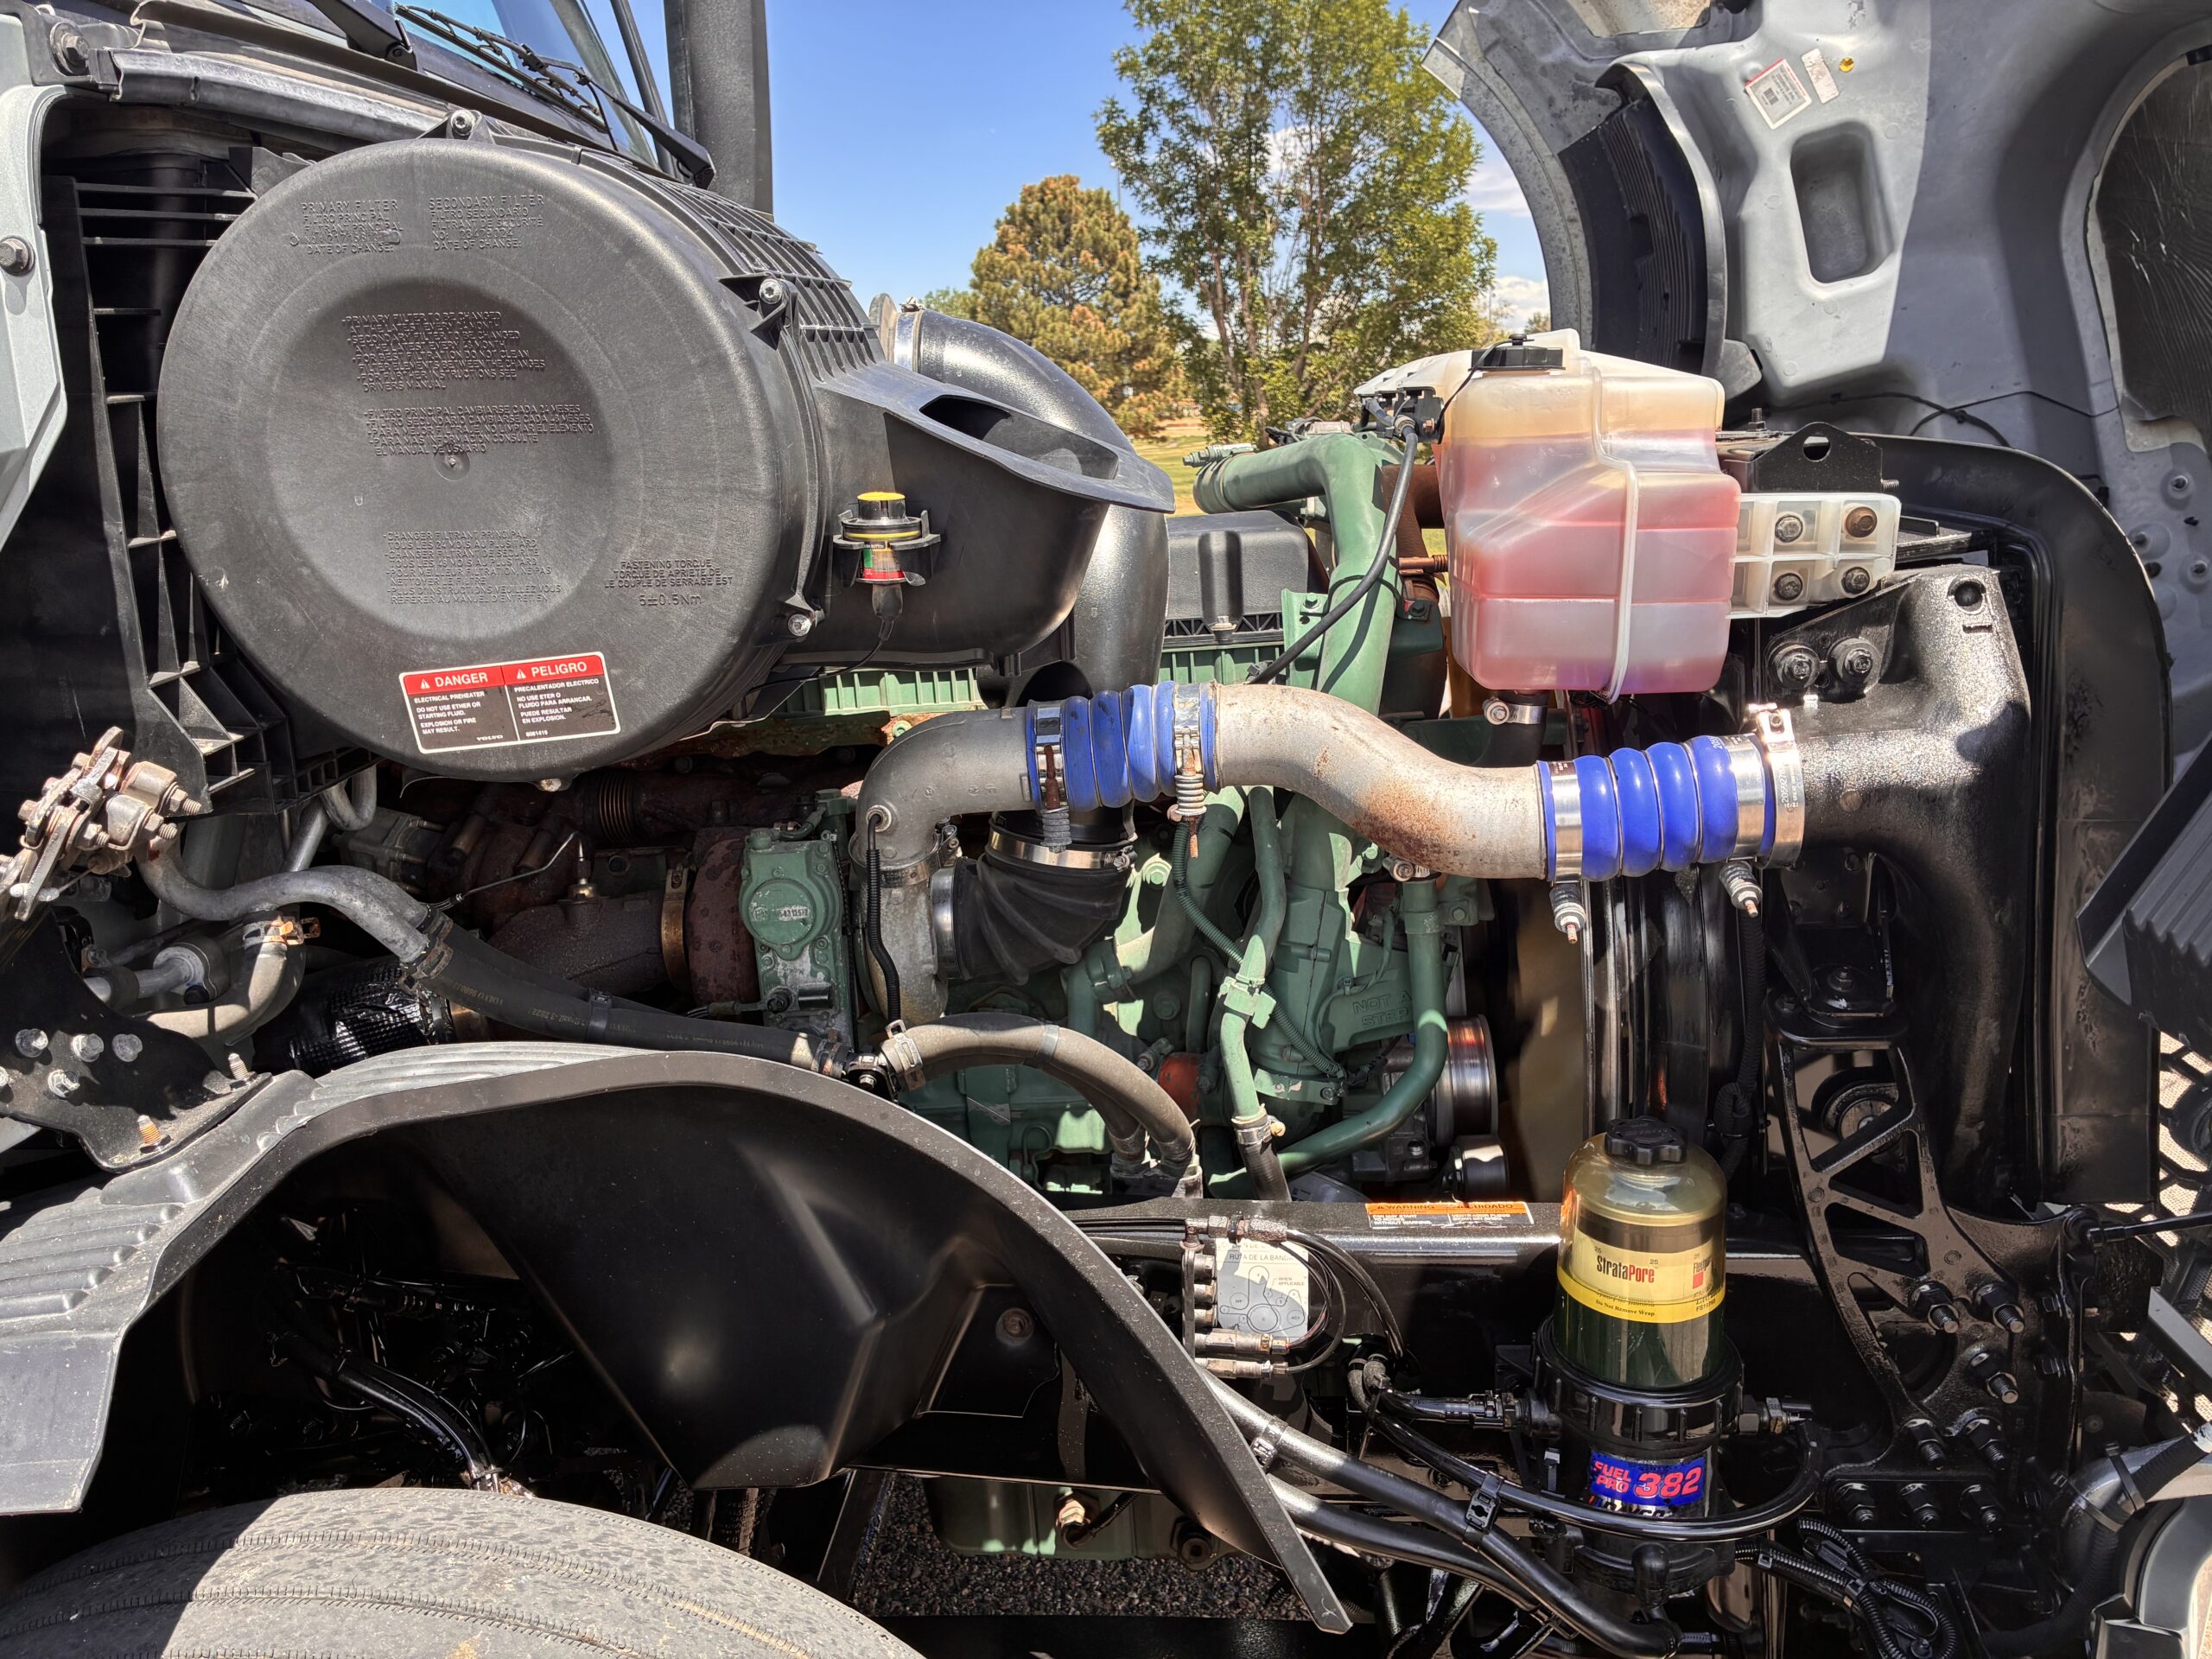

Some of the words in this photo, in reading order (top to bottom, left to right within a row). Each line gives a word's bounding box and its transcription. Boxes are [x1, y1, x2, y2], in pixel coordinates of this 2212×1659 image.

[355, 199, 397, 212] FILTER
[429, 196, 495, 209] SECONDARY
[501, 194, 544, 207] FILTER
[308, 245, 333, 254] DATE
[434, 240, 460, 251] DATE
[463, 239, 475, 250] OF
[621, 560, 671, 569] FASTENING
[675, 559, 712, 569] TORQUE
[614, 569, 651, 579] TORQUE
[653, 569, 665, 578] DE
[709, 568, 721, 576] DE
[605, 580, 614, 588] LE
[618, 579, 652, 588] COUPLE
[655, 578, 667, 587] DE
[670, 577, 713, 587] SERRAGE
[716, 576, 733, 586] EST
[531, 661, 588, 677] PELIGRO
[435, 672, 488, 688] DANGER
[514, 683, 566, 693] PRECALENTADOR
[566, 678, 600, 688] ELECTRICO
[414, 695, 449, 704] ELECTRICAL
[450, 691, 485, 700] PREHEATER
[558, 696, 593, 704] ARRANCAR.
[418, 712, 447, 721] STARTING
[541, 707, 573, 715] RESULTAR
[421, 720, 453, 728] EXPLOSION
[531, 715, 567, 723] EXPLOSION.
[1352, 994, 1391, 1015] NOT
[1362, 1007, 1410, 1028] STEP
[1249, 1252, 1259, 1261] DE
[1597, 1255, 1655, 1284] StrataPore
[1615, 1306, 1637, 1314] Remove
[1593, 1460, 1631, 1483] FUEL
[1634, 1466, 1702, 1497] 382
[1596, 1474, 1630, 1494] PRO
